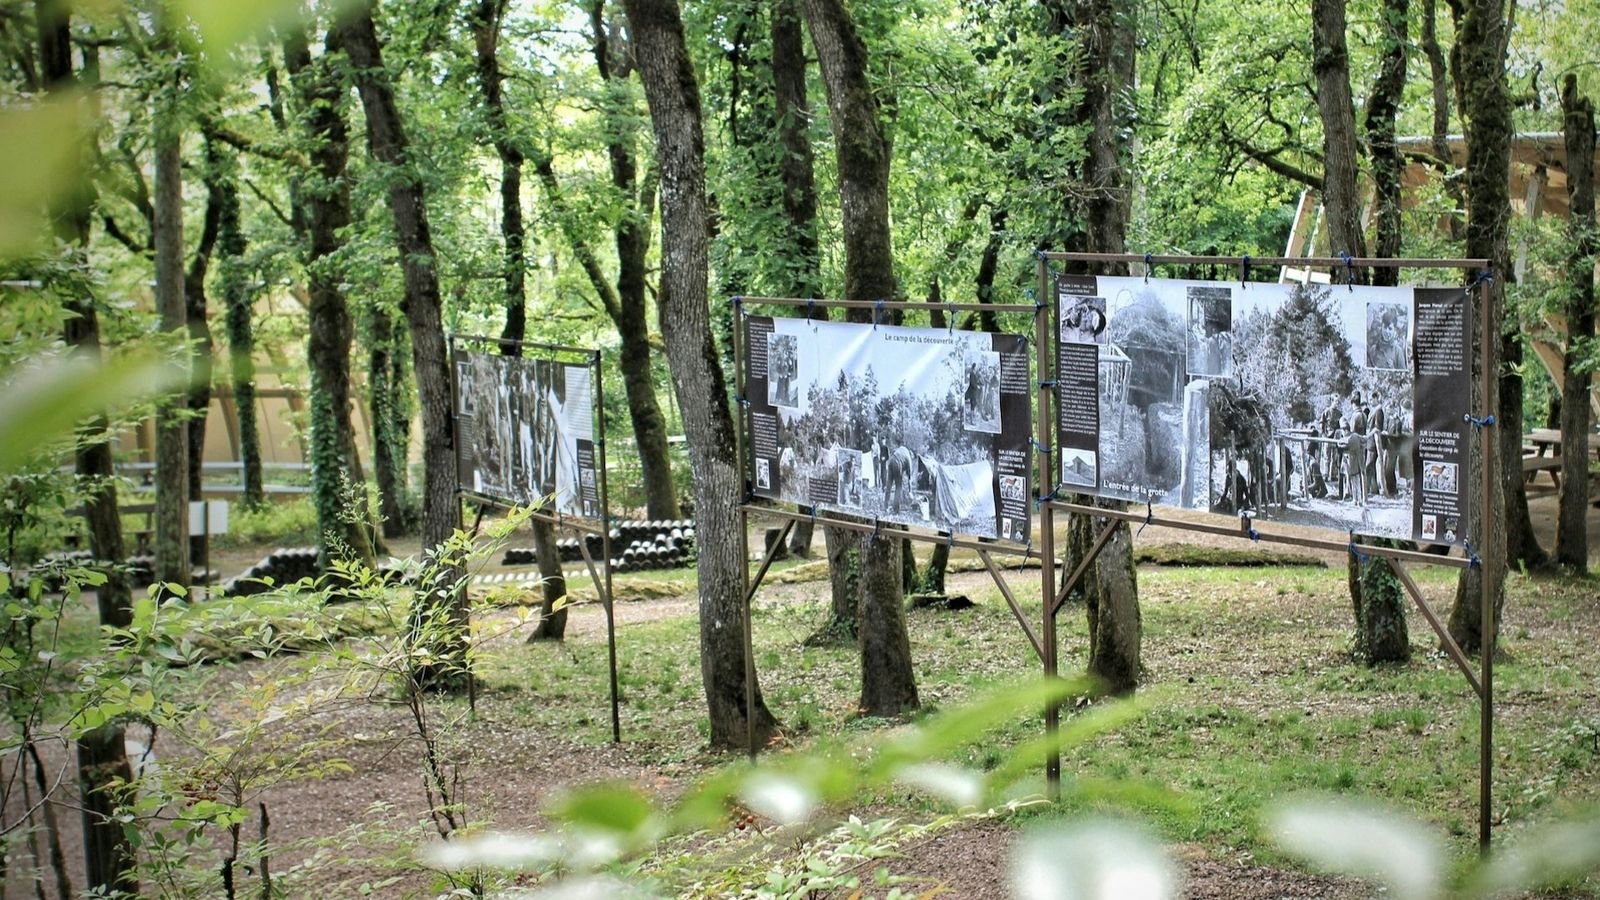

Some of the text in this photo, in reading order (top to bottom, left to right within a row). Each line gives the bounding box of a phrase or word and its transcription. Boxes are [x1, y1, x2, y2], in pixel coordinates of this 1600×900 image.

[924, 336, 954, 344] découverte
[1103, 480, 1129, 491] L'entrée
[1131, 483, 1139, 492] de
[1148, 489, 1169, 497] grotte
